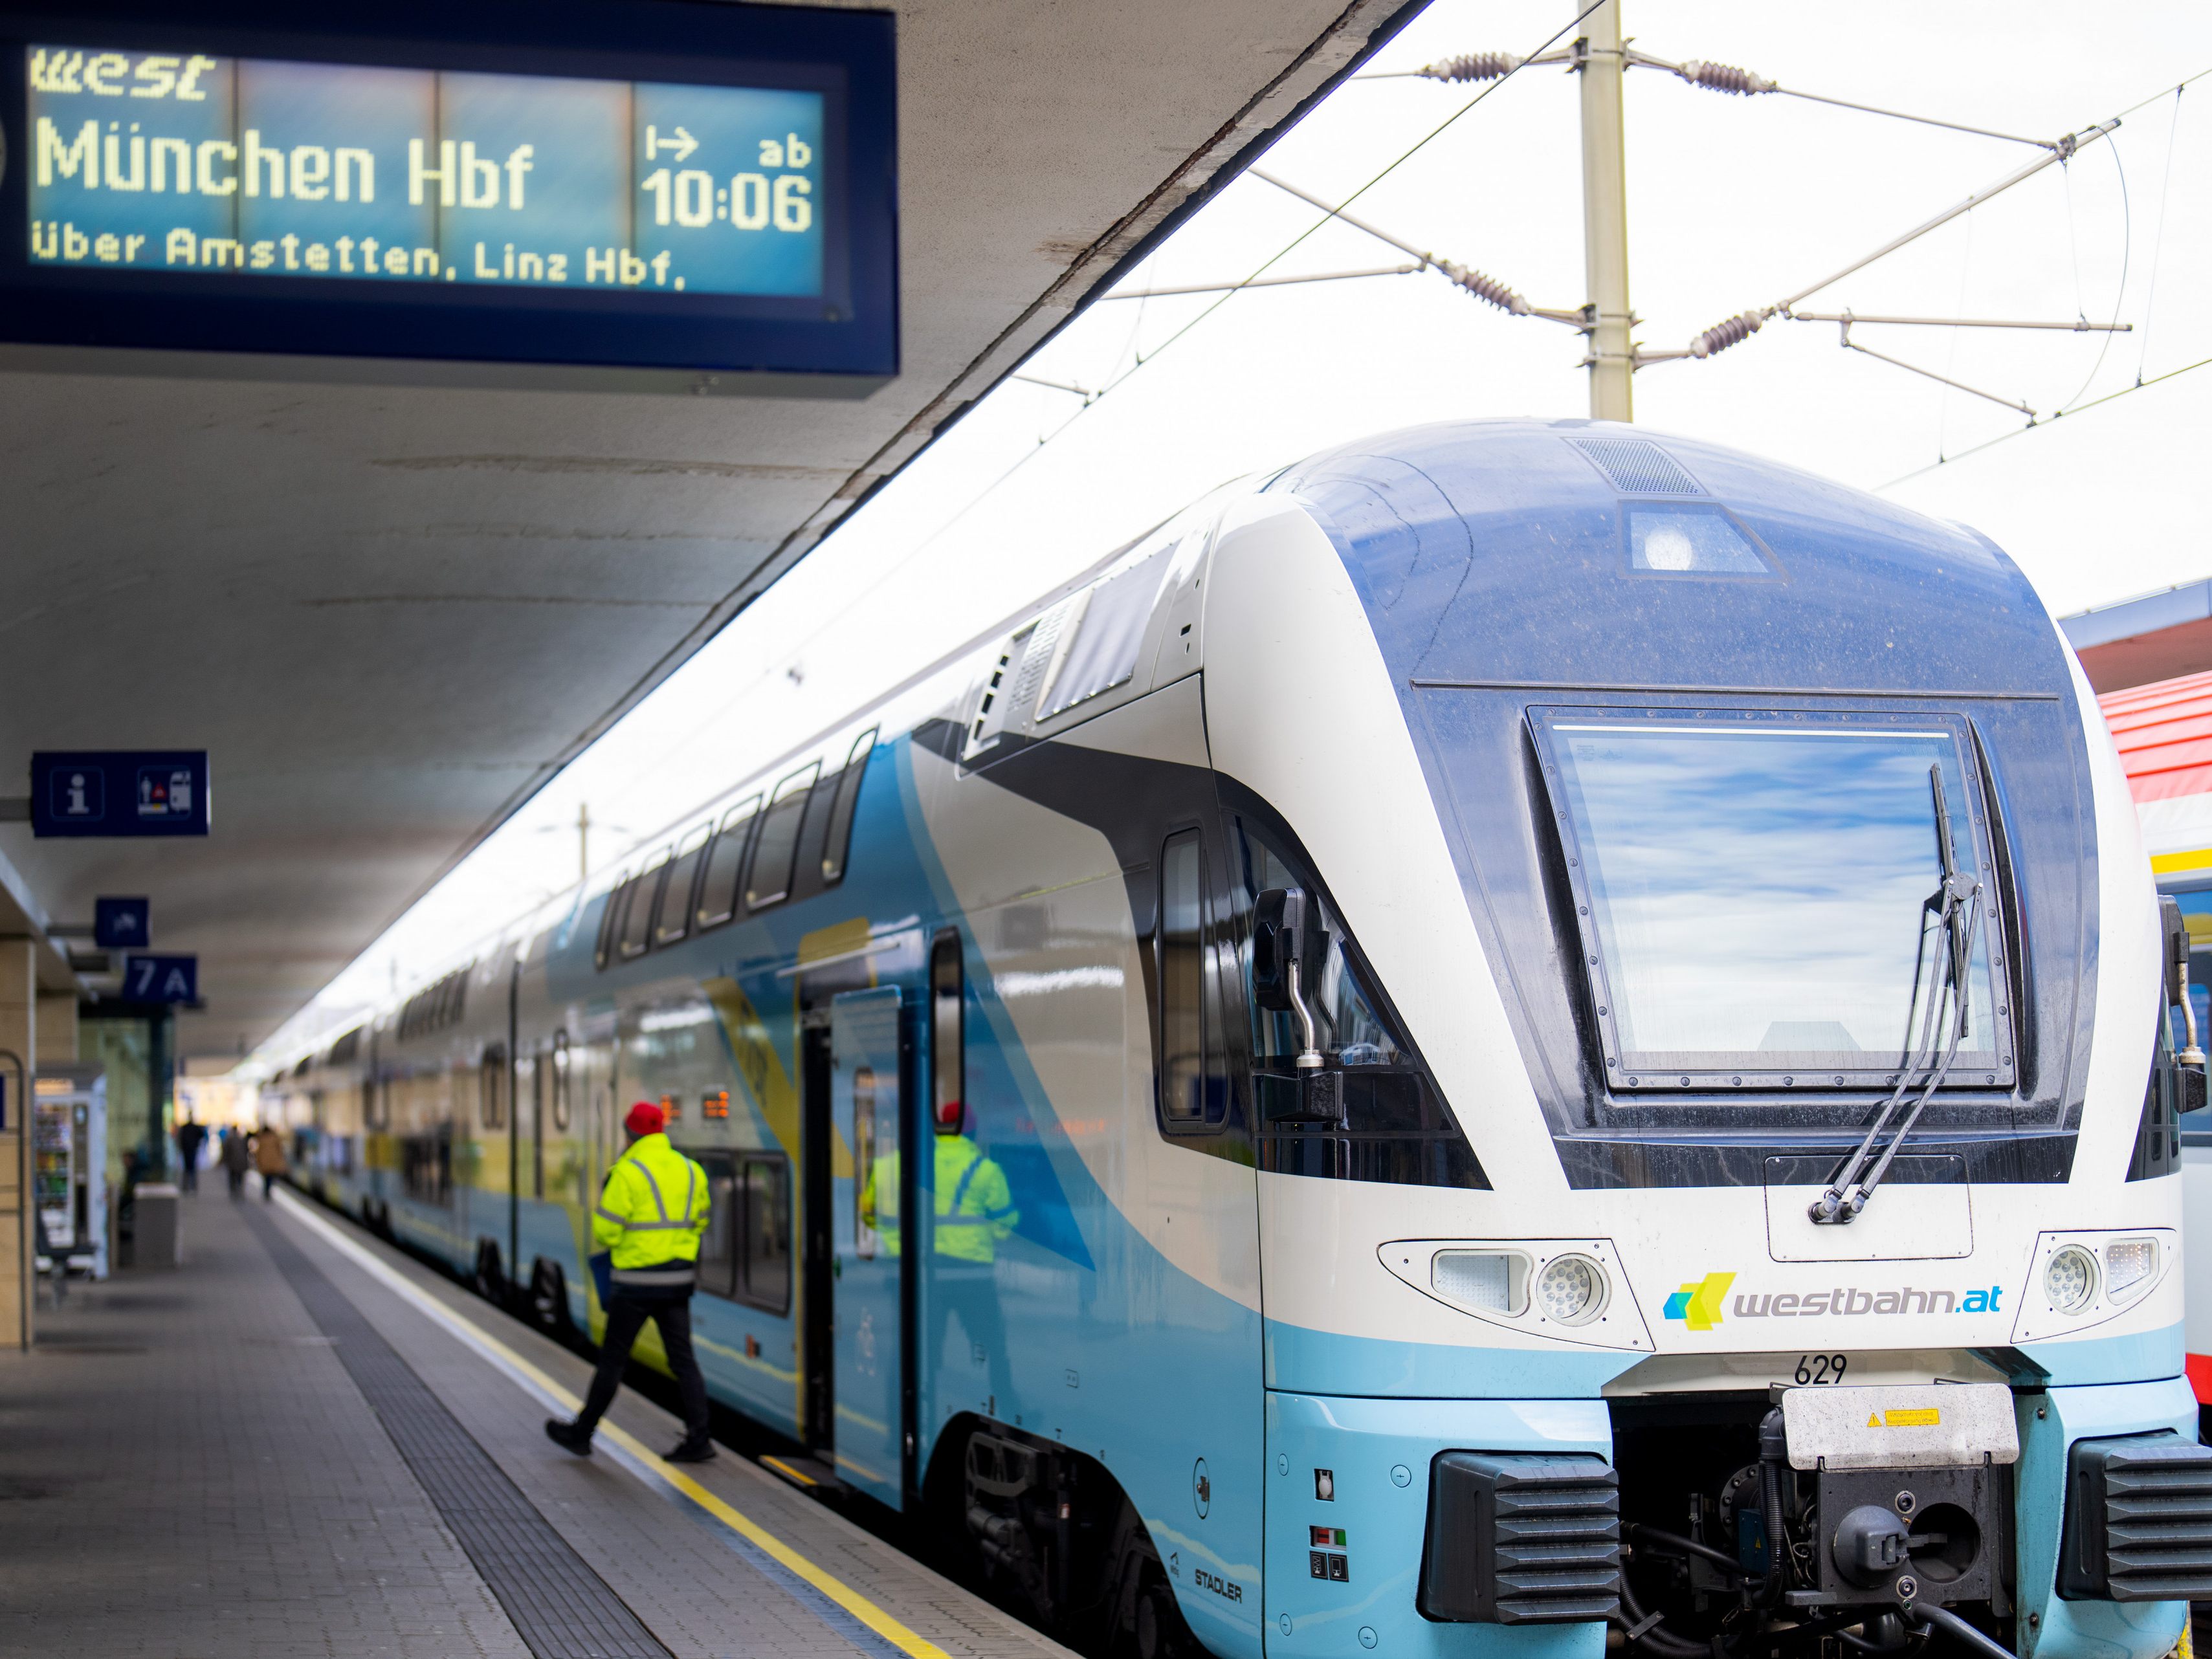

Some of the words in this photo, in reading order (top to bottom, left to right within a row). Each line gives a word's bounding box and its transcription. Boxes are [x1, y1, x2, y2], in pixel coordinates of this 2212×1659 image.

[37, 116, 375, 203] München
[408, 138, 534, 210] Hbf
[758, 132, 812, 168] ab
[642, 168, 812, 232] 10:06
[32, 220, 146, 262] über
[474, 241, 568, 281] Linz
[133, 960, 157, 996] 7
[163, 967, 188, 996] A
[1733, 1285, 2003, 1317] westbahn.at
[1795, 1354, 1847, 1385] 629
[1195, 1568, 1242, 1604] STADLER
